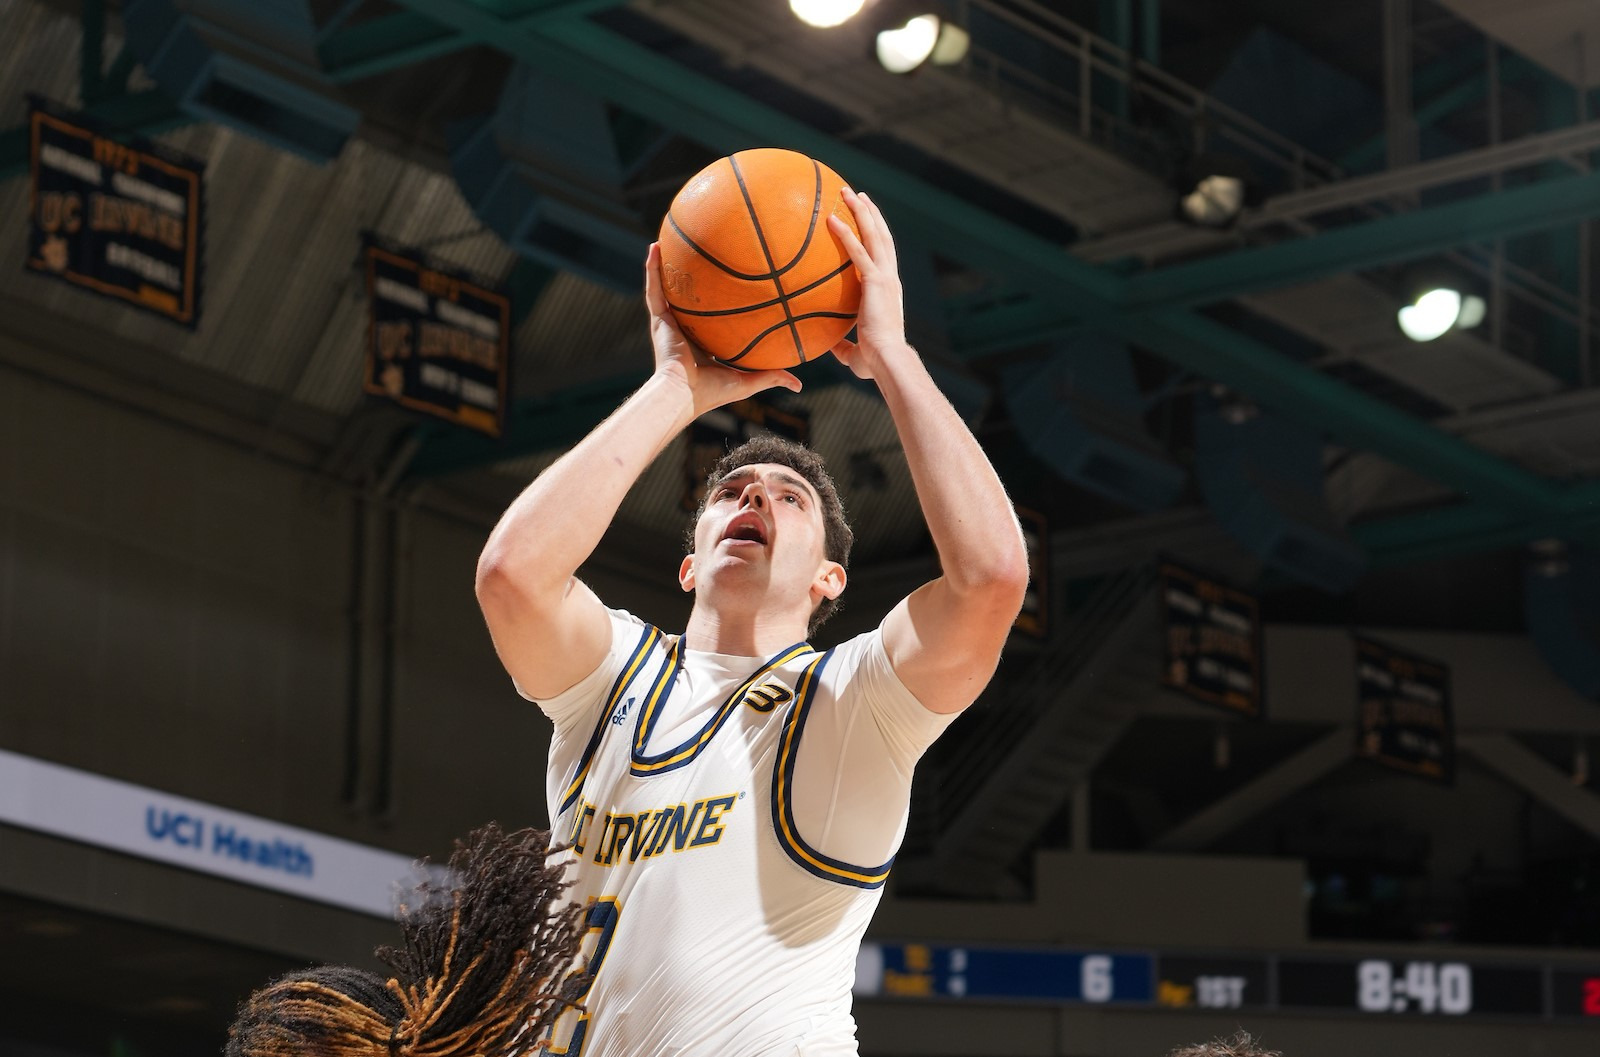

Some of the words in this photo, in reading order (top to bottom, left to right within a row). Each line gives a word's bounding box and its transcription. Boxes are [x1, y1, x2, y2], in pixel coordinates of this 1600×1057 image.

[145, 805, 204, 849] UCI
[212, 823, 314, 880] Health
[593, 792, 740, 868] IRVINE
[1081, 954, 1114, 1003] 6
[1195, 974, 1247, 1010] 1ST
[1357, 959, 1472, 1016] 8:40
